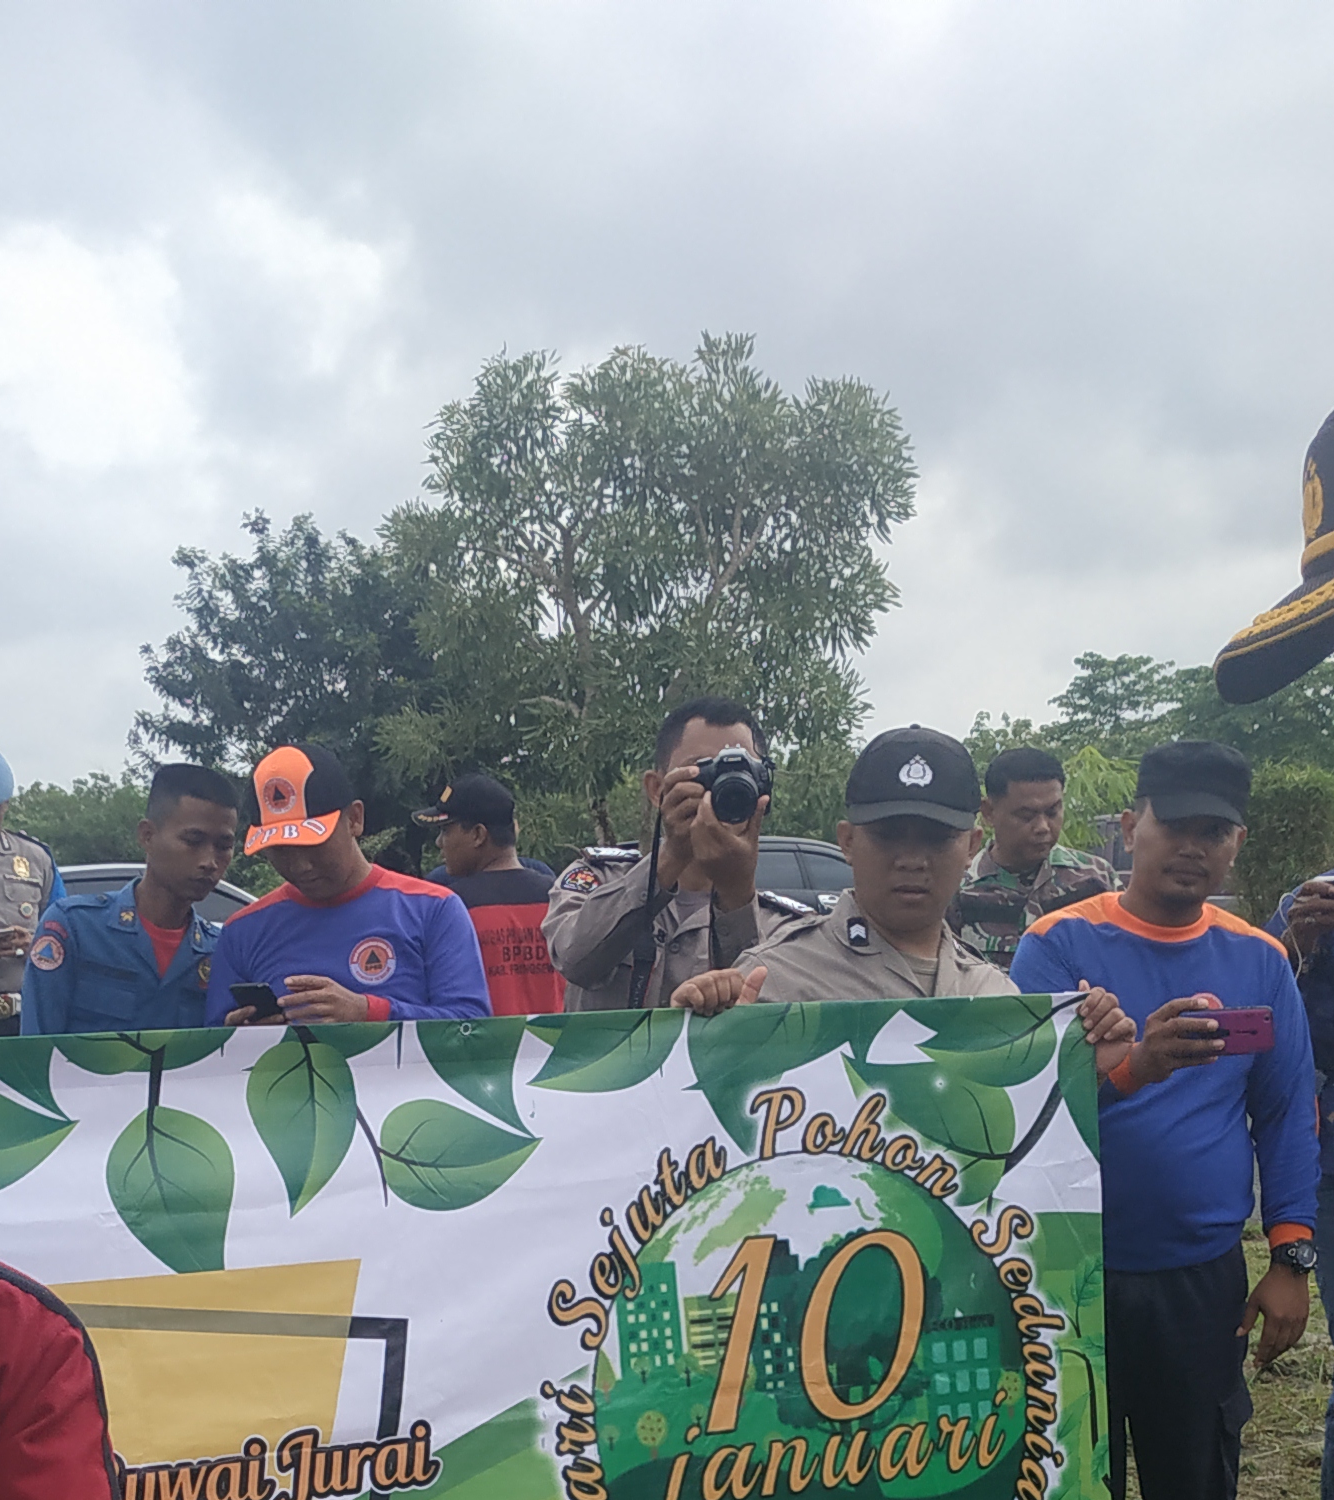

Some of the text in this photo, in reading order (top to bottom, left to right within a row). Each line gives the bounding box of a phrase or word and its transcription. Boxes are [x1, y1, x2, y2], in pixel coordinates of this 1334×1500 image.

[503, 945, 546, 962] BPBD
[549, 1135, 727, 1352] Sejuta
[750, 1086, 958, 1200] Pohon
[704, 1228, 926, 1434] 10
